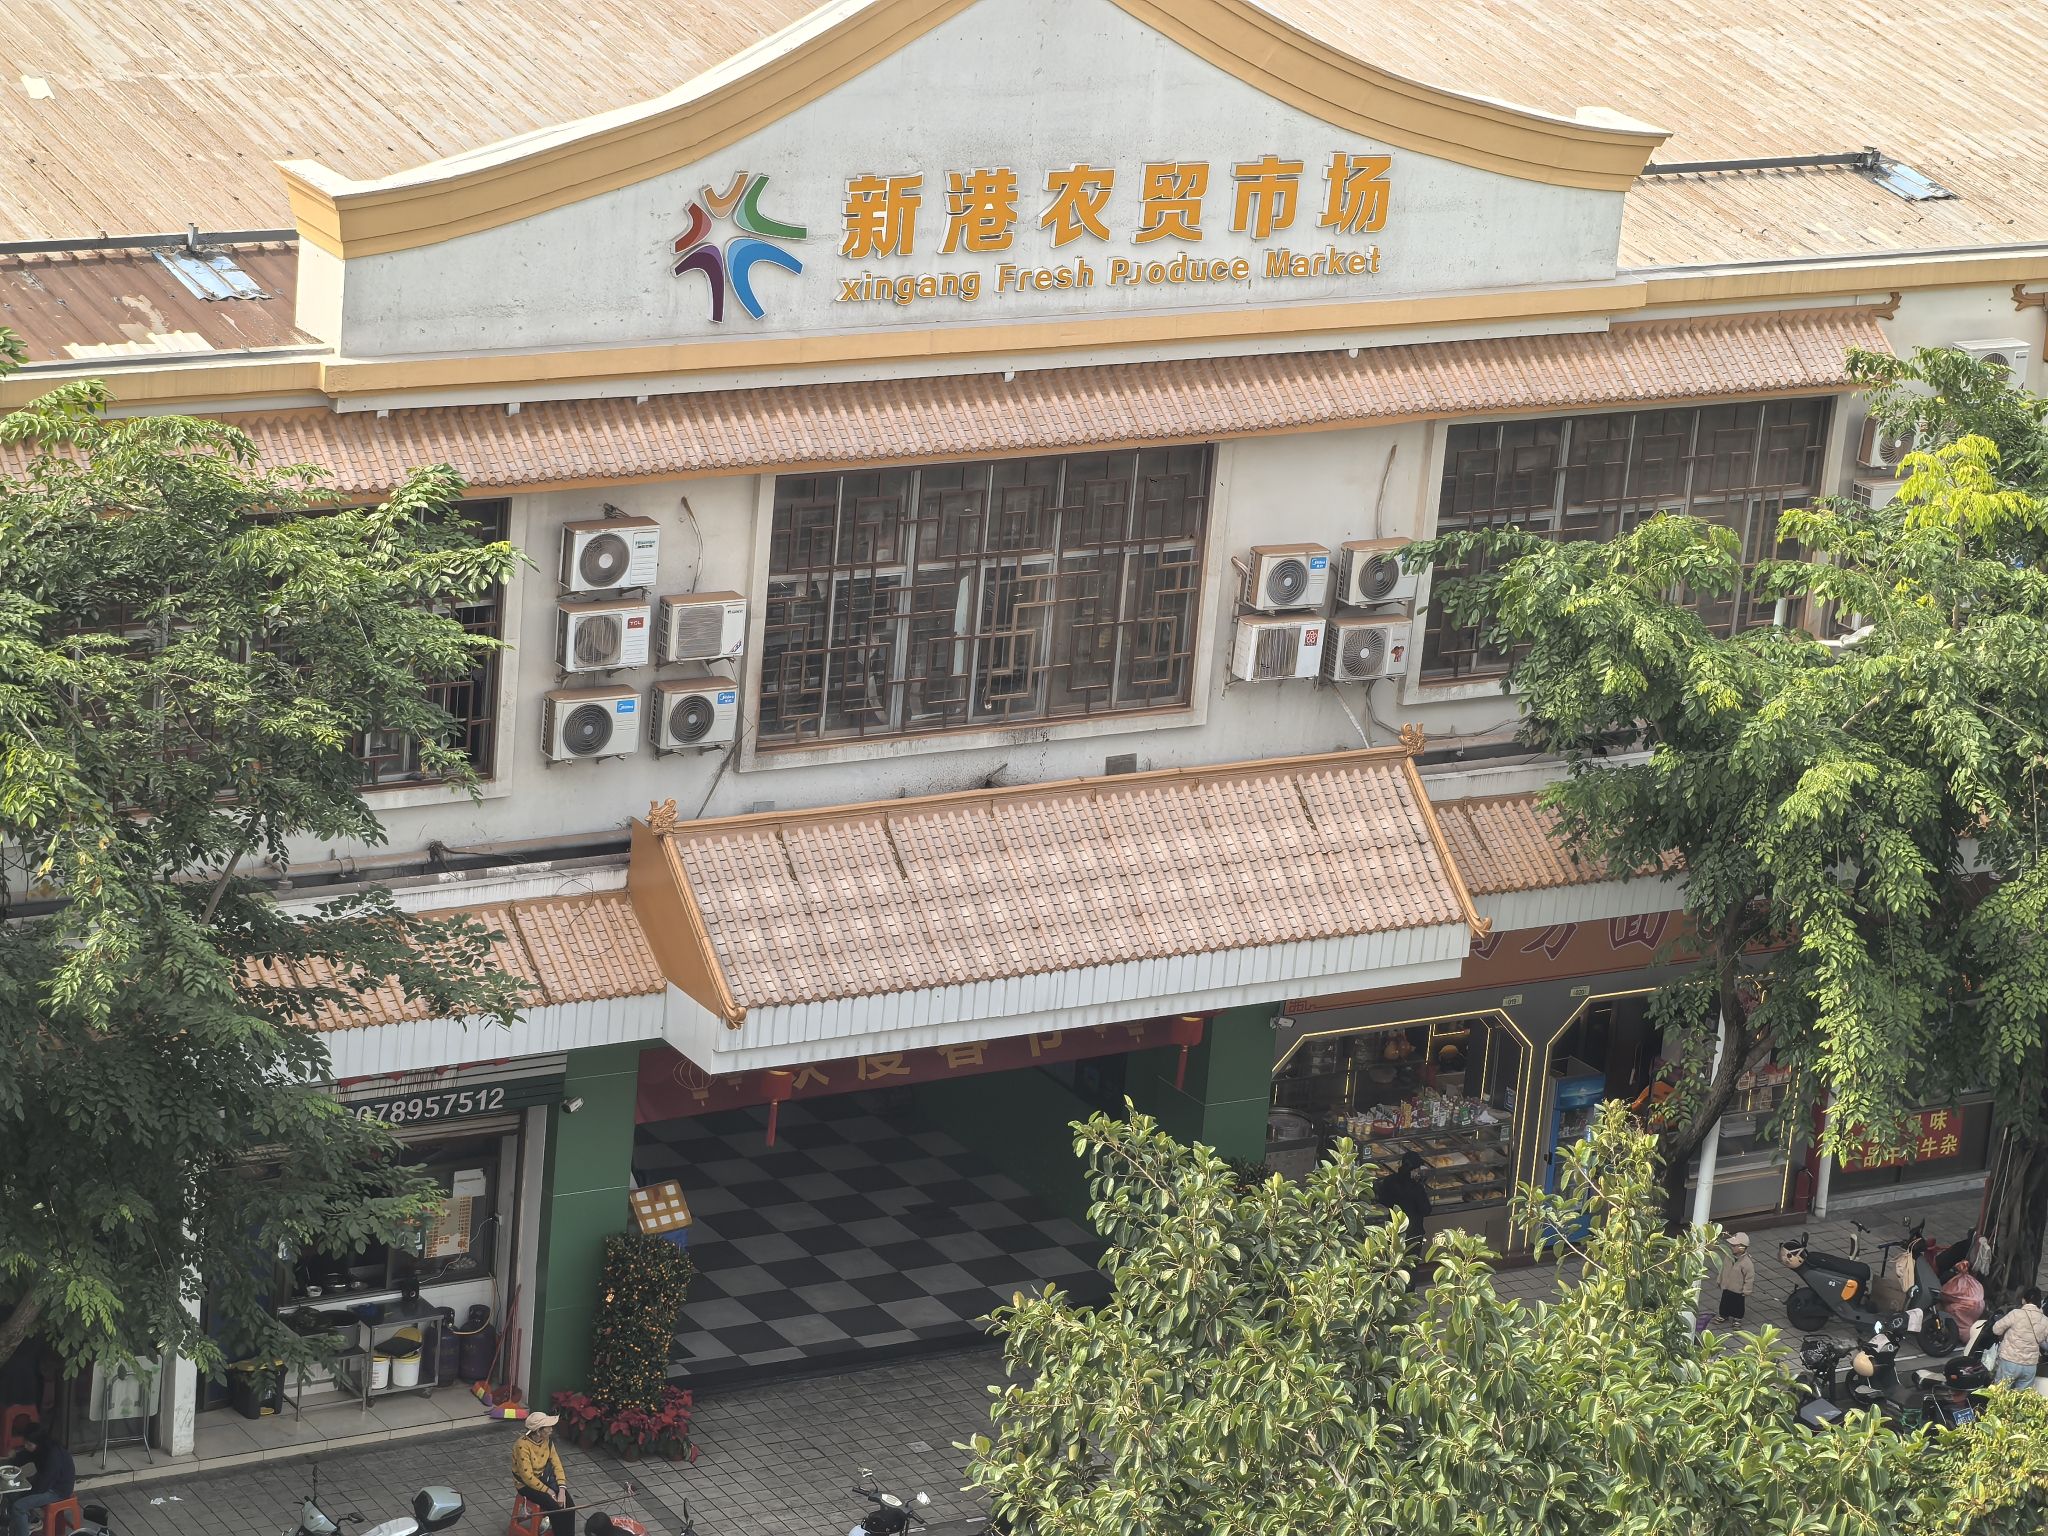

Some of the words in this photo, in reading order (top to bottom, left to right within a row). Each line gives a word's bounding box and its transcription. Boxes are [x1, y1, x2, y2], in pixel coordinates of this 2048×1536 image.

[837, 151, 1393, 261] 新港农贸市场
[994, 256, 1094, 292] Fresh
[1262, 244, 1381, 279] Market
